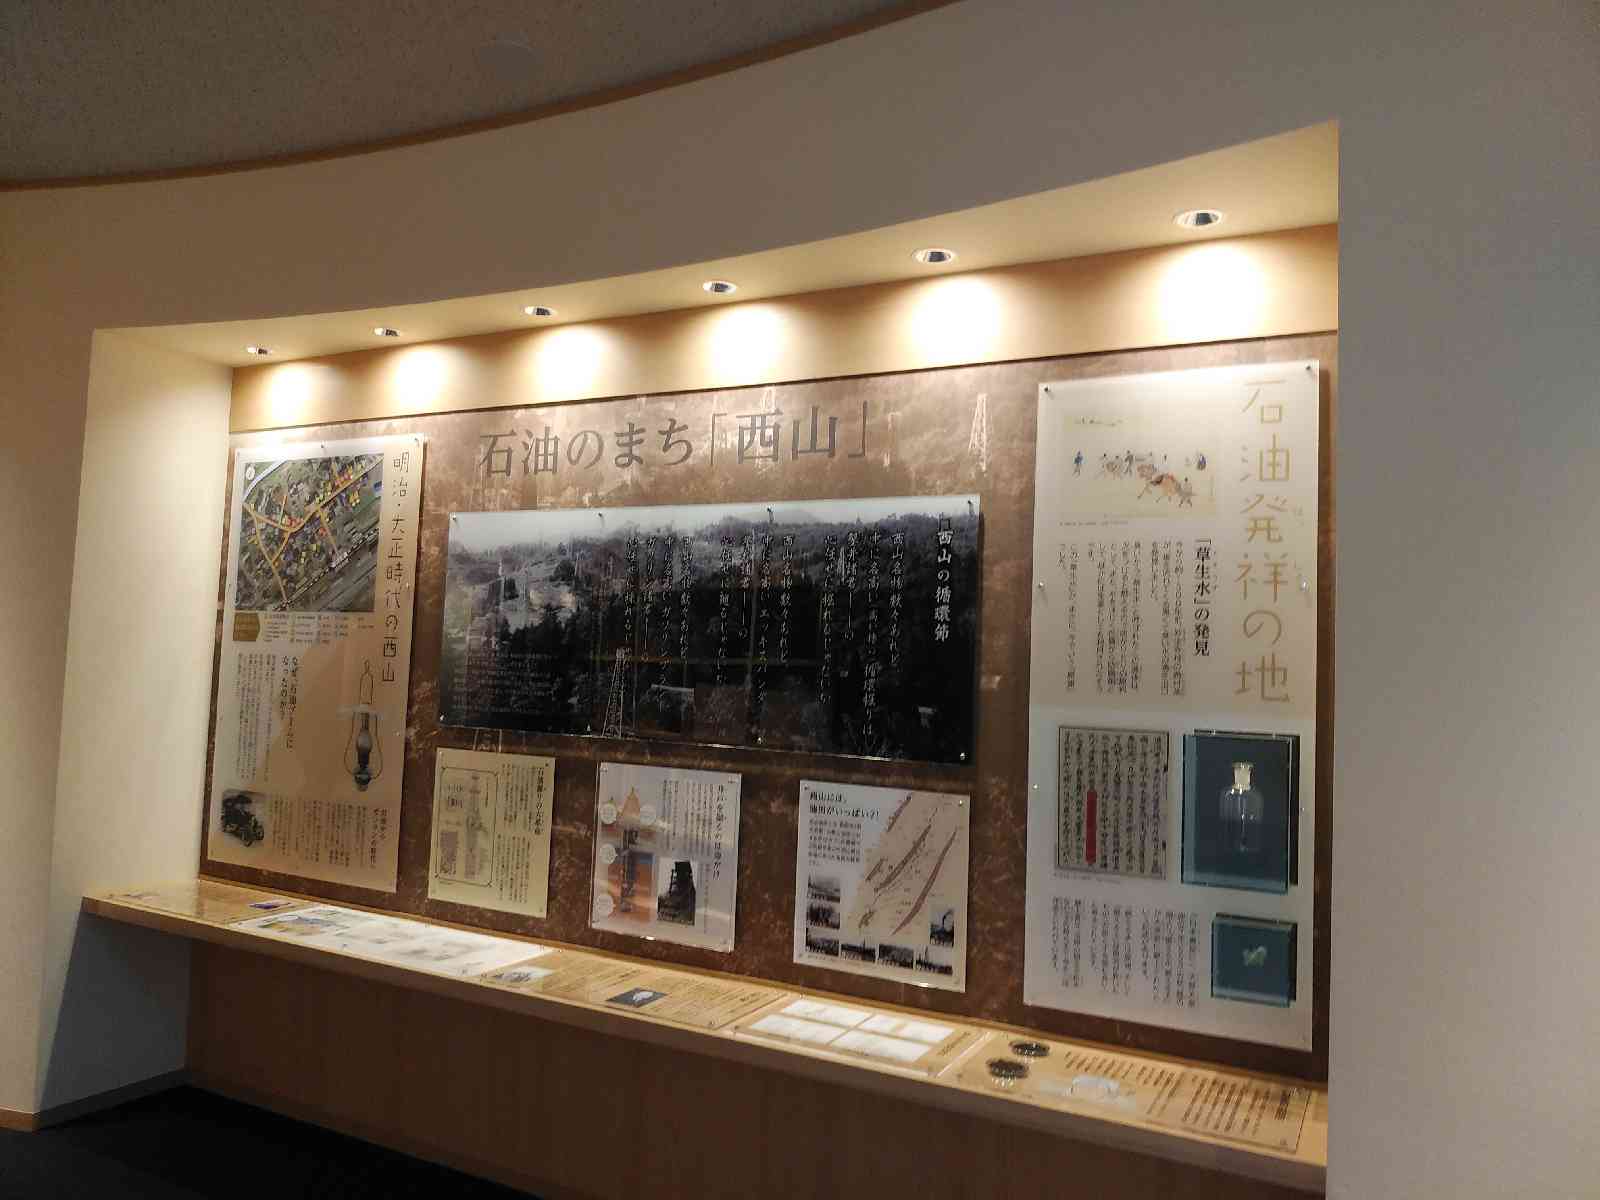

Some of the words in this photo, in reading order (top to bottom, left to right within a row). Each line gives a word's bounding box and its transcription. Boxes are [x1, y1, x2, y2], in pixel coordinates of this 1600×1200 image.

[479, 400, 868, 478] 石油のまち「西山」
[382, 451, 410, 681] 明治・大正時代の西山
[1193, 538, 1212, 656] 「草生水」の発見
[1235, 379, 1290, 702] 石油発祥の地
